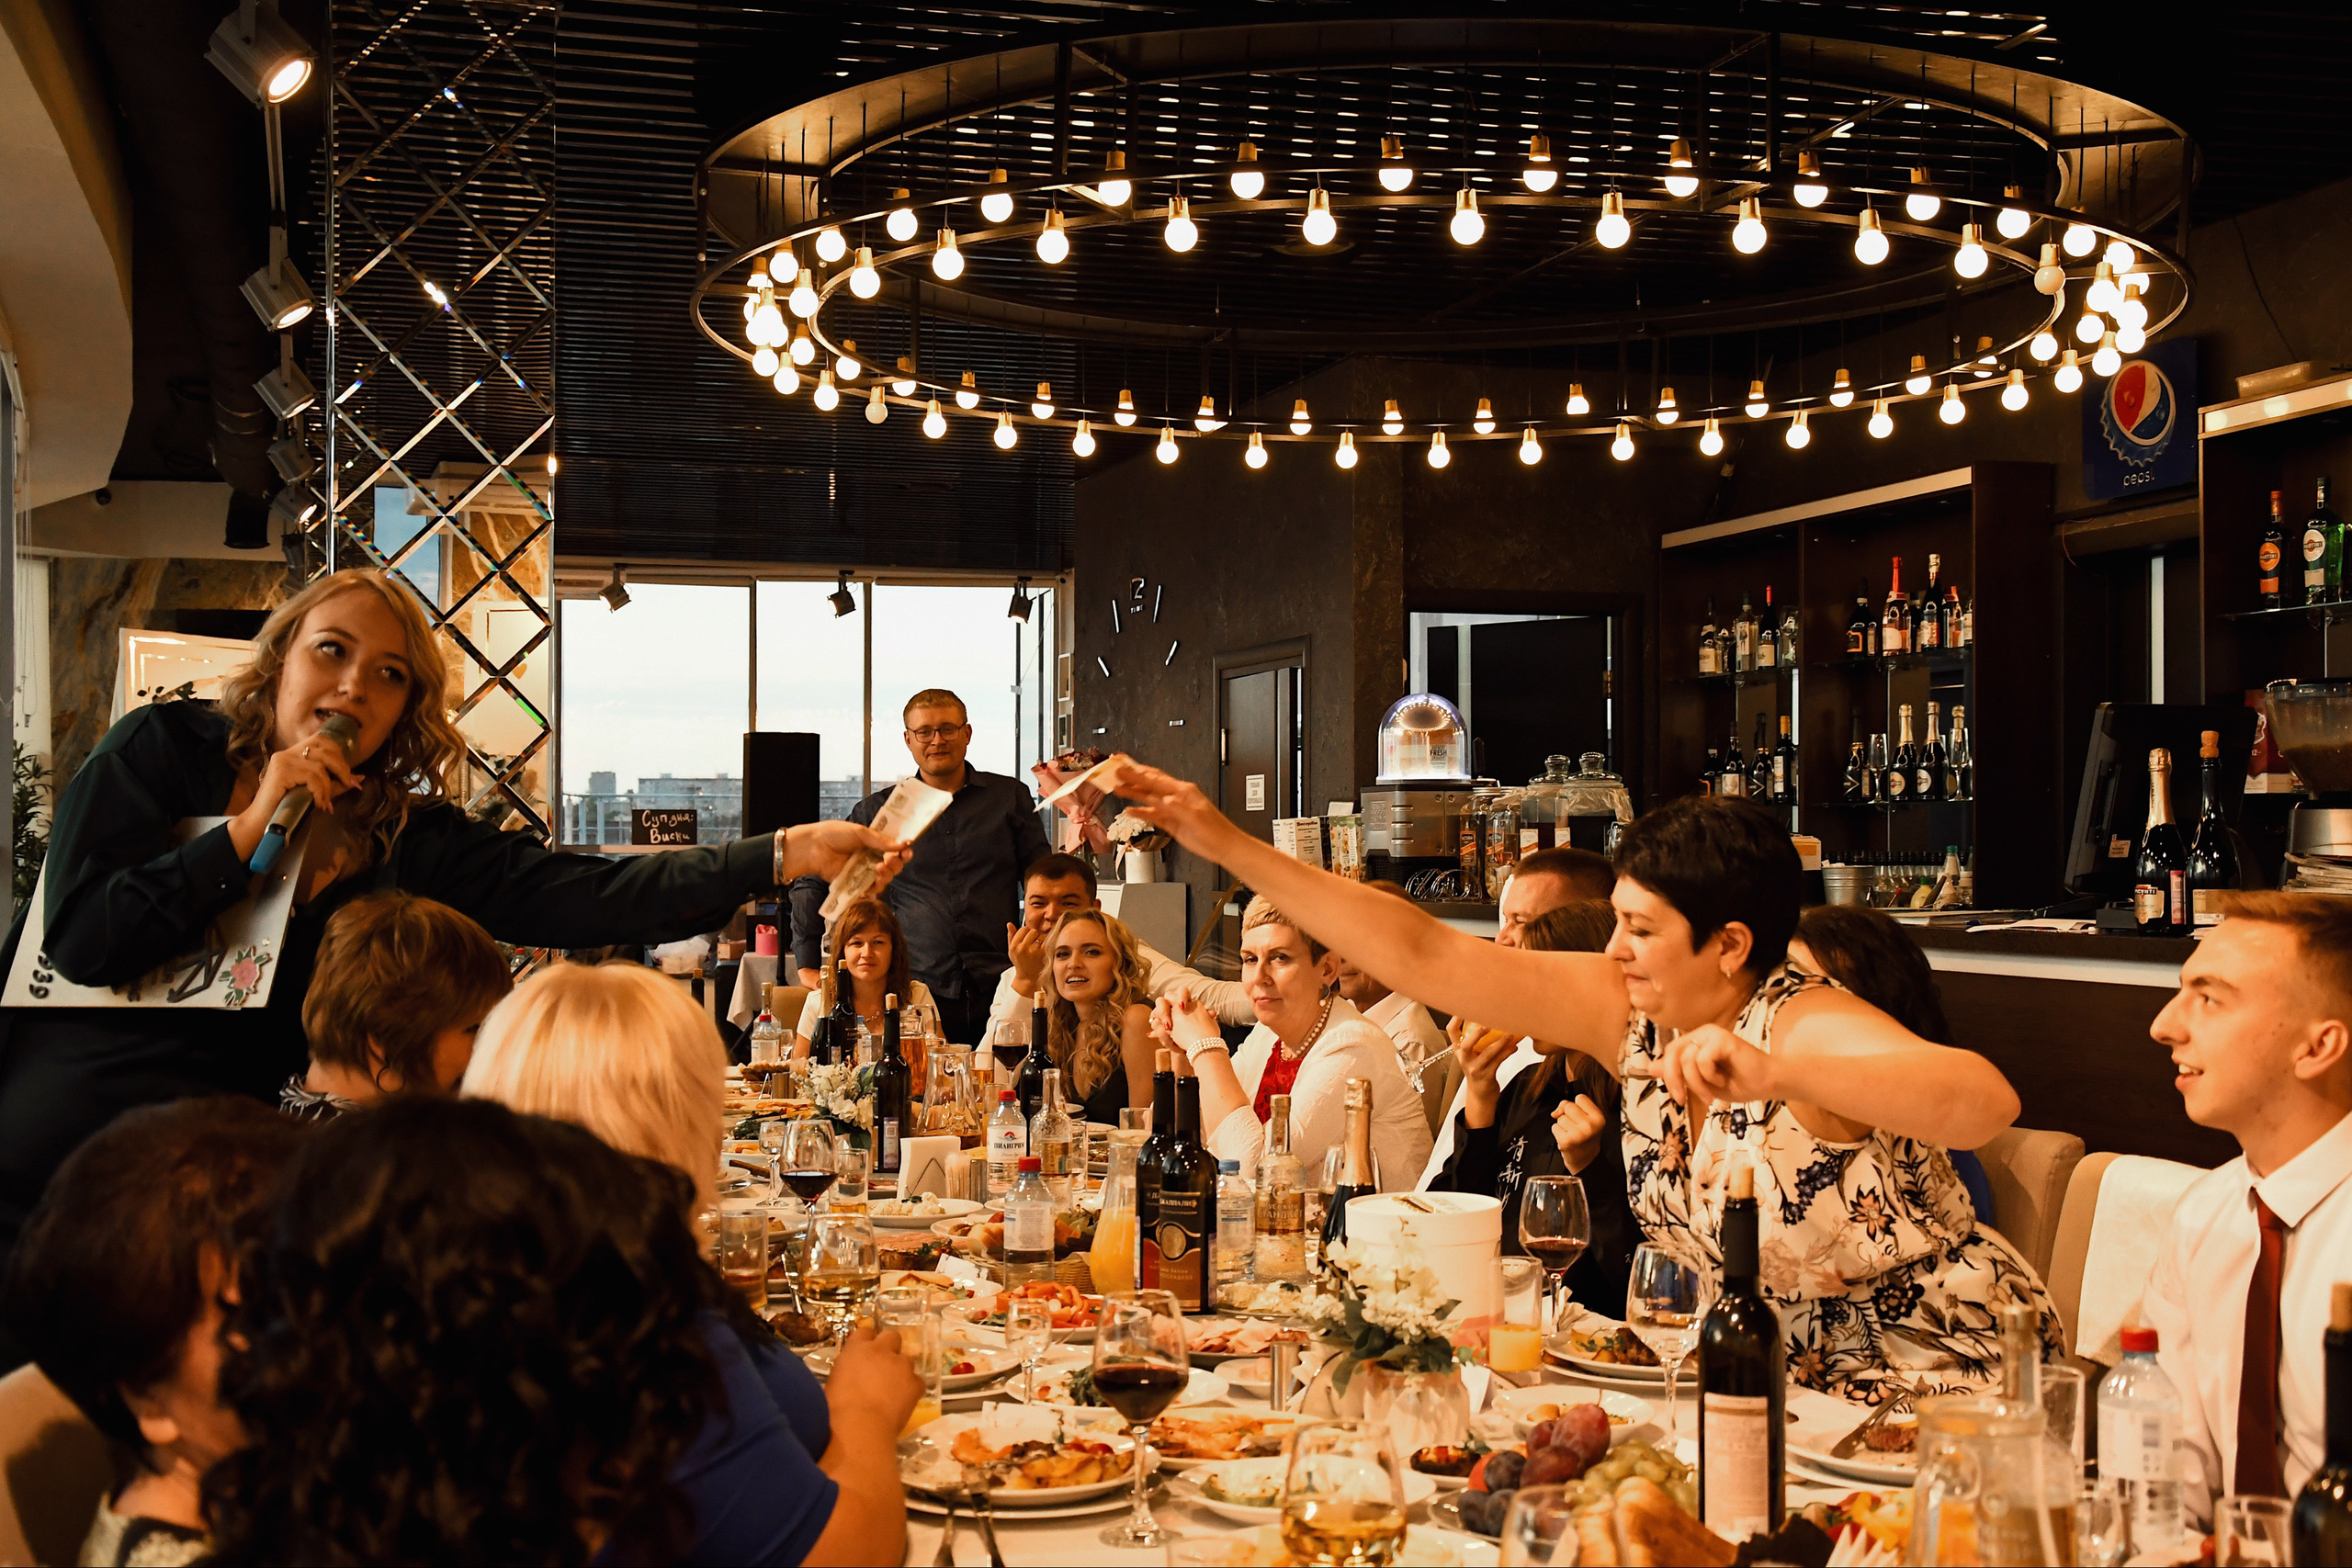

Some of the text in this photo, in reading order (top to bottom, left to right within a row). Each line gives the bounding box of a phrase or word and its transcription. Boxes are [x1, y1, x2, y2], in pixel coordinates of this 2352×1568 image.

[2123, 468, 2154, 490] pepsi
[641, 809, 668, 828] Суп
[650, 828, 691, 844] Виски
